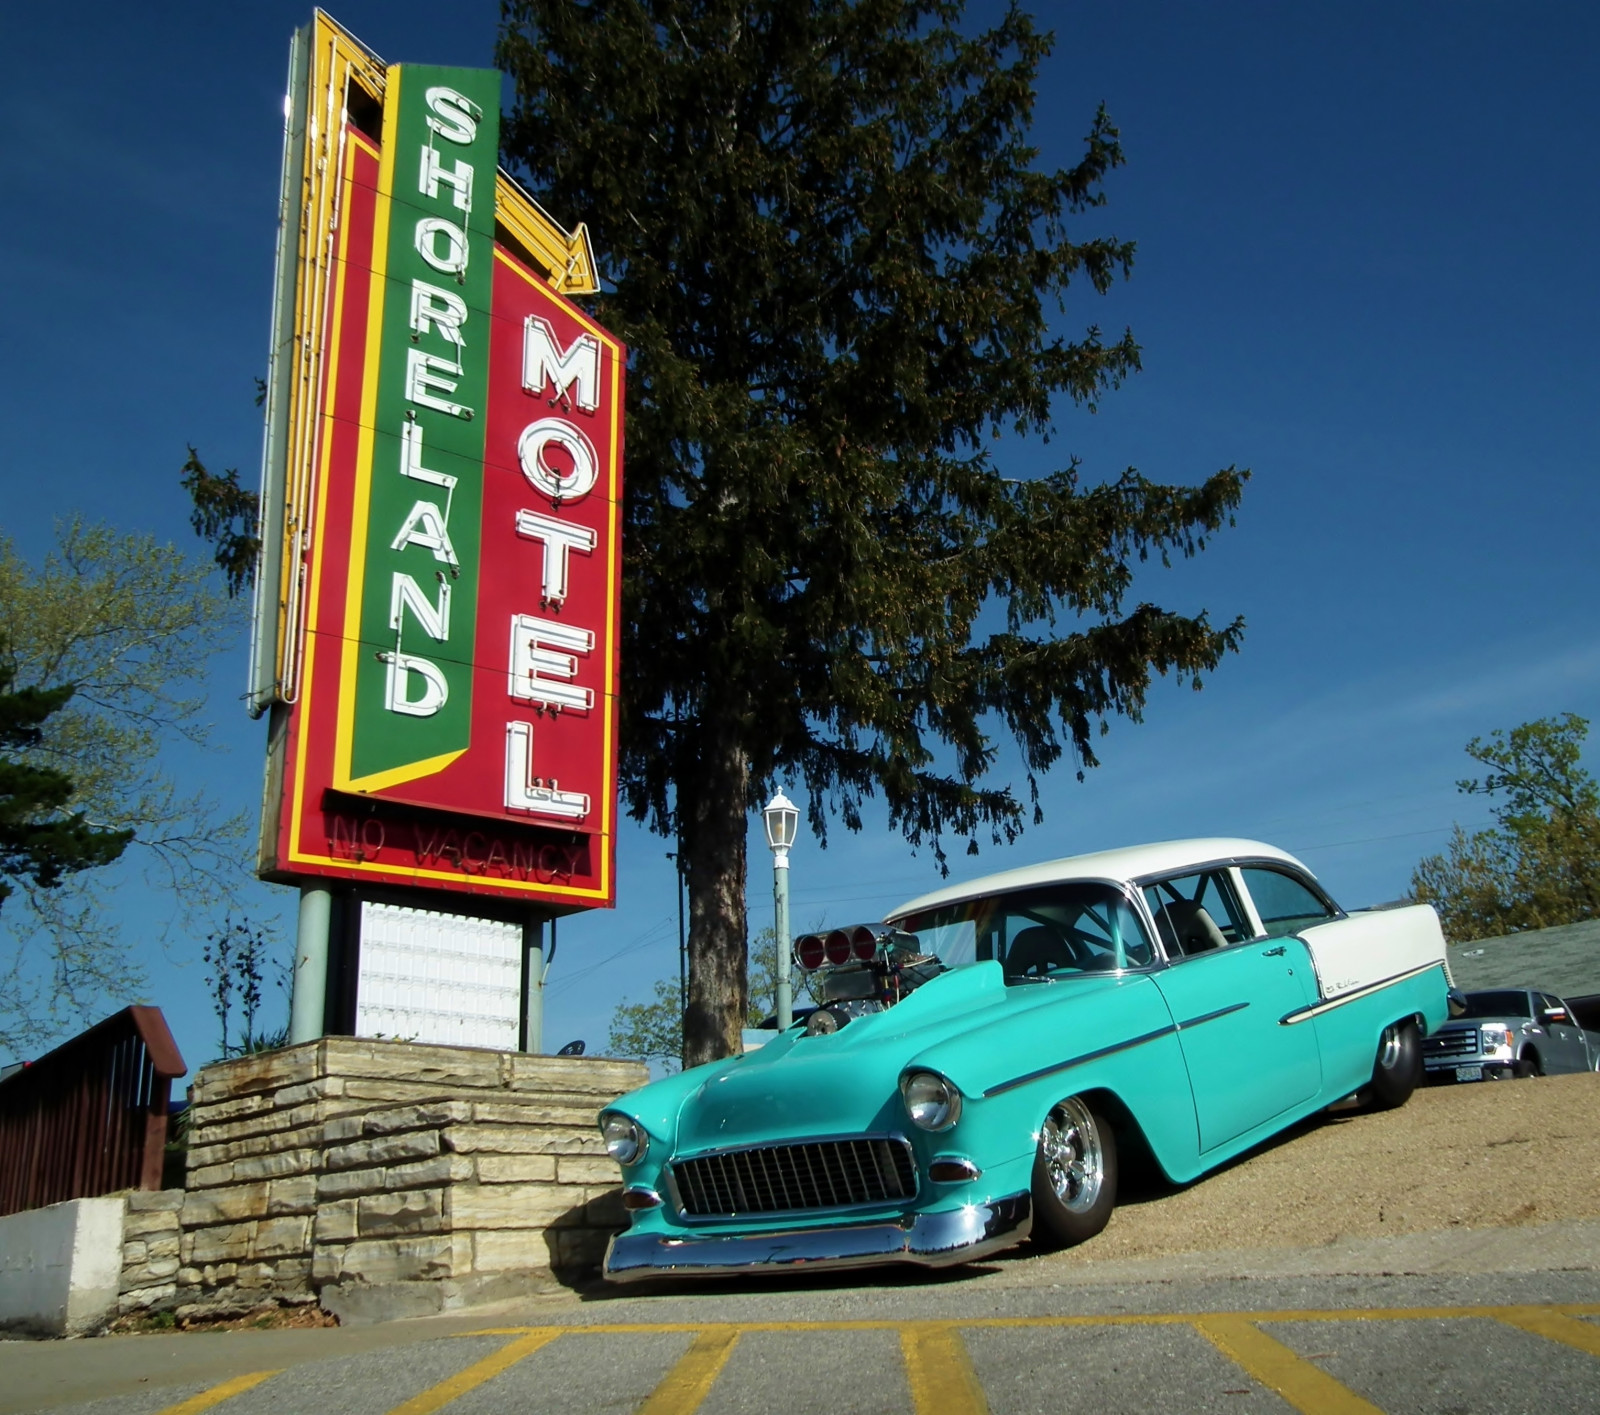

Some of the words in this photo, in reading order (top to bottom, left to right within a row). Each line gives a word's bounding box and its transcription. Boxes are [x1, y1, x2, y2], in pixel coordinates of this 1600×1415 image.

[385, 86, 483, 717] SHORELAND
[503, 314, 600, 817] MOTEL
[331, 815, 385, 851] NO
[414, 823, 583, 877] VACANCY
